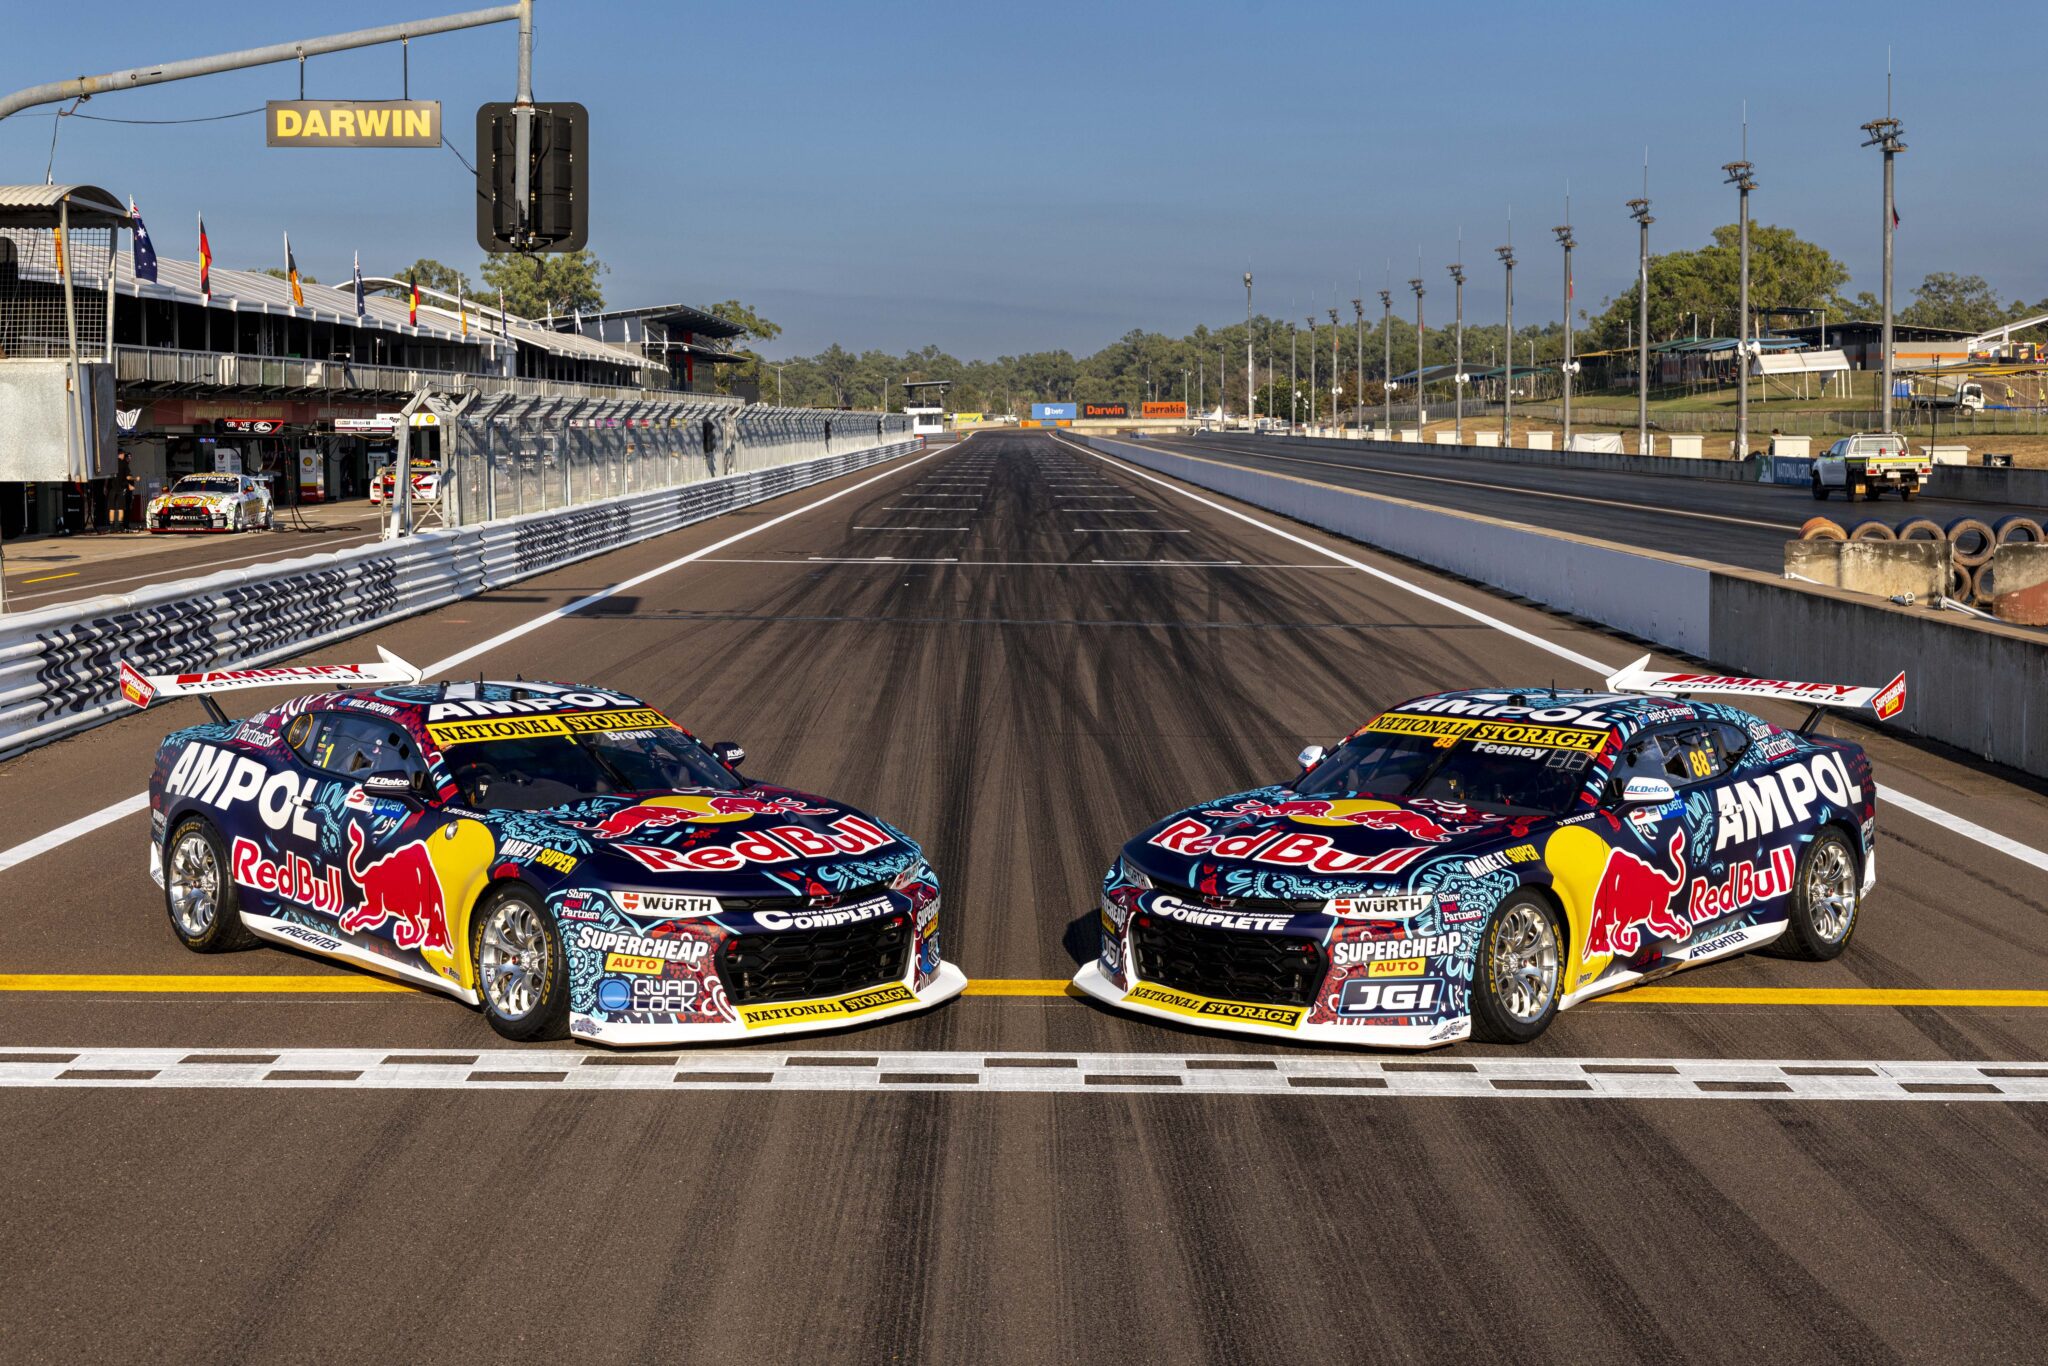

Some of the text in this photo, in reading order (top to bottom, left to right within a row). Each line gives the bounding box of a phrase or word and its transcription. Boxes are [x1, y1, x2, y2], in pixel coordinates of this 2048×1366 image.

[276, 109, 431, 137] DARWIN
[1086, 405, 1125, 415] Darwin
[1144, 404, 1185, 414] Larrakia
[121, 668, 152, 699] SUPERCHEAP
[178, 672, 378, 691] Premium Fuels
[206, 664, 361, 682] AMPLIFY
[127, 686, 139, 698] AUTO
[1650, 682, 1846, 702] Premium Fuels
[1694, 675, 1858, 695] AMPLIFY
[1875, 679, 1905, 711] SUPERCHEAP
[348, 699, 398, 716] WILL BROWN
[428, 692, 641, 721] AMPOL
[1395, 698, 1611, 729] AMPOL
[1648, 706, 1694, 722] BROC FEENEY
[1886, 699, 1898, 711] AUTO
[236, 723, 274, 748] Partners
[432, 712, 664, 742] NATIONAL STORAGE
[603, 729, 657, 741] Brown
[1369, 716, 1598, 749] NATIONAL STORAGE
[1749, 723, 1773, 741] Shaw
[1432, 737, 1457, 748] 88
[1472, 741, 1549, 760] Feeney
[1758, 737, 1795, 758] Partners
[322, 743, 335, 769] 1
[1689, 750, 1711, 777] 88
[165, 741, 318, 842] AMPOL
[367, 776, 410, 786] ACDelco
[1626, 785, 1669, 793] ACDelco
[1715, 751, 1862, 851] AMPOL
[448, 807, 487, 820] DUNLOP
[1564, 812, 1596, 825] DUNLOP
[610, 814, 897, 873] Red Bull
[1148, 817, 1438, 874] Red Bull
[499, 838, 577, 874] MAKE IT SUPER
[1464, 843, 1541, 879] MAKE IT SUPER
[232, 836, 344, 917] Red Bull
[1688, 861, 1738, 926] Red
[1736, 844, 1797, 909] Bull
[567, 888, 592, 900] Shaw
[643, 896, 712, 912] WÜRTH
[1354, 897, 1423, 913] WÜRTH
[1438, 892, 1461, 903] Shaw
[561, 906, 600, 920] Partners
[753, 899, 894, 931] COMPLETE
[1151, 895, 1290, 931] COMPLETE
[1443, 909, 1482, 922] Partners
[283, 925, 342, 951] FREIGHTER
[577, 926, 709, 968] SUPERCHEAP
[1333, 931, 1462, 965] SUPERCHEAP
[1691, 931, 1749, 958] FREIGHTER
[541, 931, 553, 1005] DUNLOP
[612, 957, 657, 970] AUTO
[1374, 960, 1419, 972] AUTO
[1488, 920, 1500, 993] DUNLOP
[633, 979, 698, 996] QUAD
[1348, 984, 1436, 1011] JGI
[633, 996, 697, 1012] LOCK
[744, 986, 913, 1024] NATIONAL STORAGE
[1130, 986, 1296, 1024] NATIONAL STORAGE
